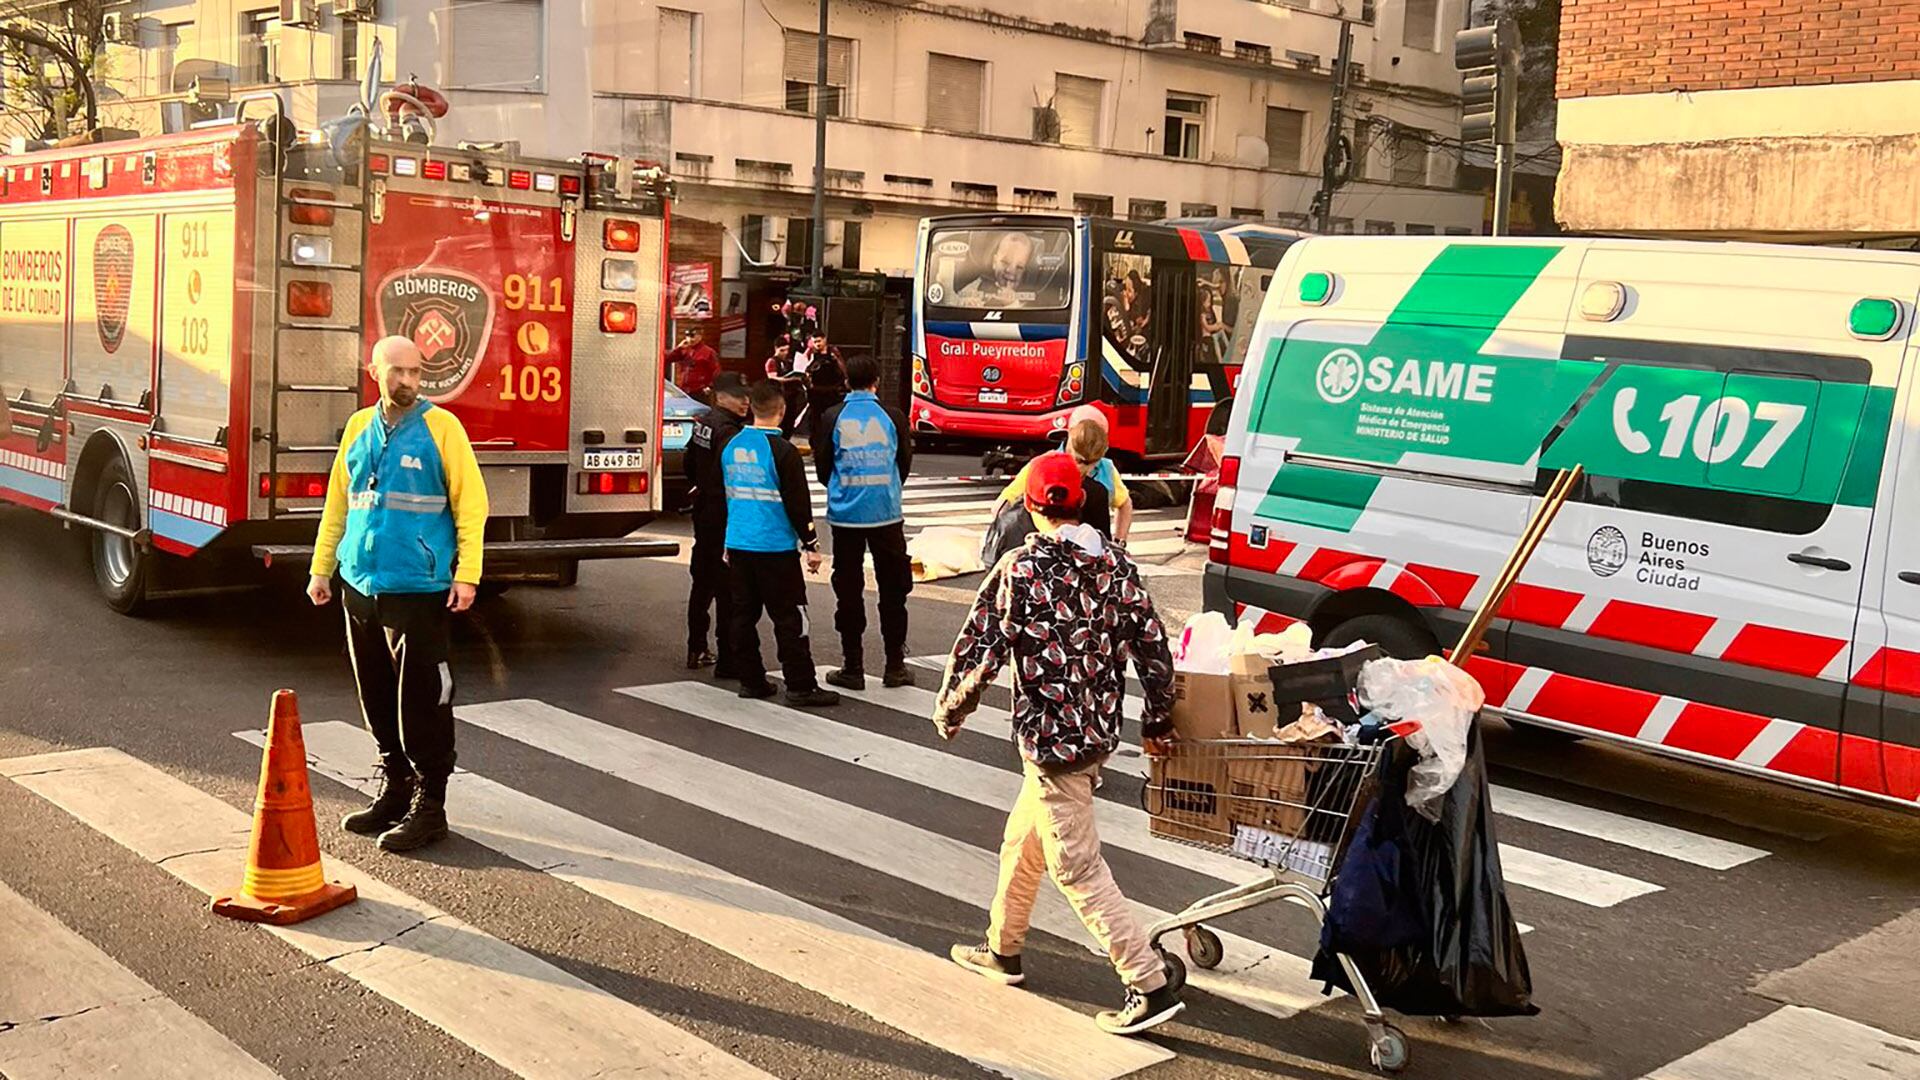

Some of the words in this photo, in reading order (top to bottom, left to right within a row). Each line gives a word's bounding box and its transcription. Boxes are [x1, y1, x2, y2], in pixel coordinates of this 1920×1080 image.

[182, 221, 208, 258] 911
[3, 250, 62, 282] BOMBEROS
[3, 287, 13, 311] DE
[16, 288, 26, 312] LA
[28, 288, 61, 315] CIUDAD
[394, 278, 479, 303] BOMBEROS
[504, 274, 566, 312] 911
[931, 288, 941, 300] 60
[181, 317, 208, 355] 103
[940, 342, 969, 355] Gral.
[973, 342, 1045, 359] Pueyrredon
[500, 364, 561, 402] 103
[1365, 356, 1497, 402] SAME
[1358, 414, 1387, 426] Médica
[1389, 417, 1399, 427] de
[1400, 418, 1450, 433] Emergencia
[1360, 402, 1392, 415] Sistema
[1394, 406, 1405, 416] de
[1406, 407, 1444, 420] Atención
[839, 417, 890, 449] BA
[1356, 426, 1405, 440] MINISTERIO
[1406, 431, 1418, 441] DE
[1420, 433, 1450, 445] SALUD
[1659, 394, 1807, 469] 107
[400, 454, 422, 470] BA
[587, 455, 600, 467] AB
[603, 455, 624, 467] 649
[627, 454, 640, 466] BM
[733, 447, 759, 463] BA
[1641, 532, 1709, 557] Buenos
[1639, 551, 1685, 571] Aires
[1637, 567, 1700, 591] Ciudad
